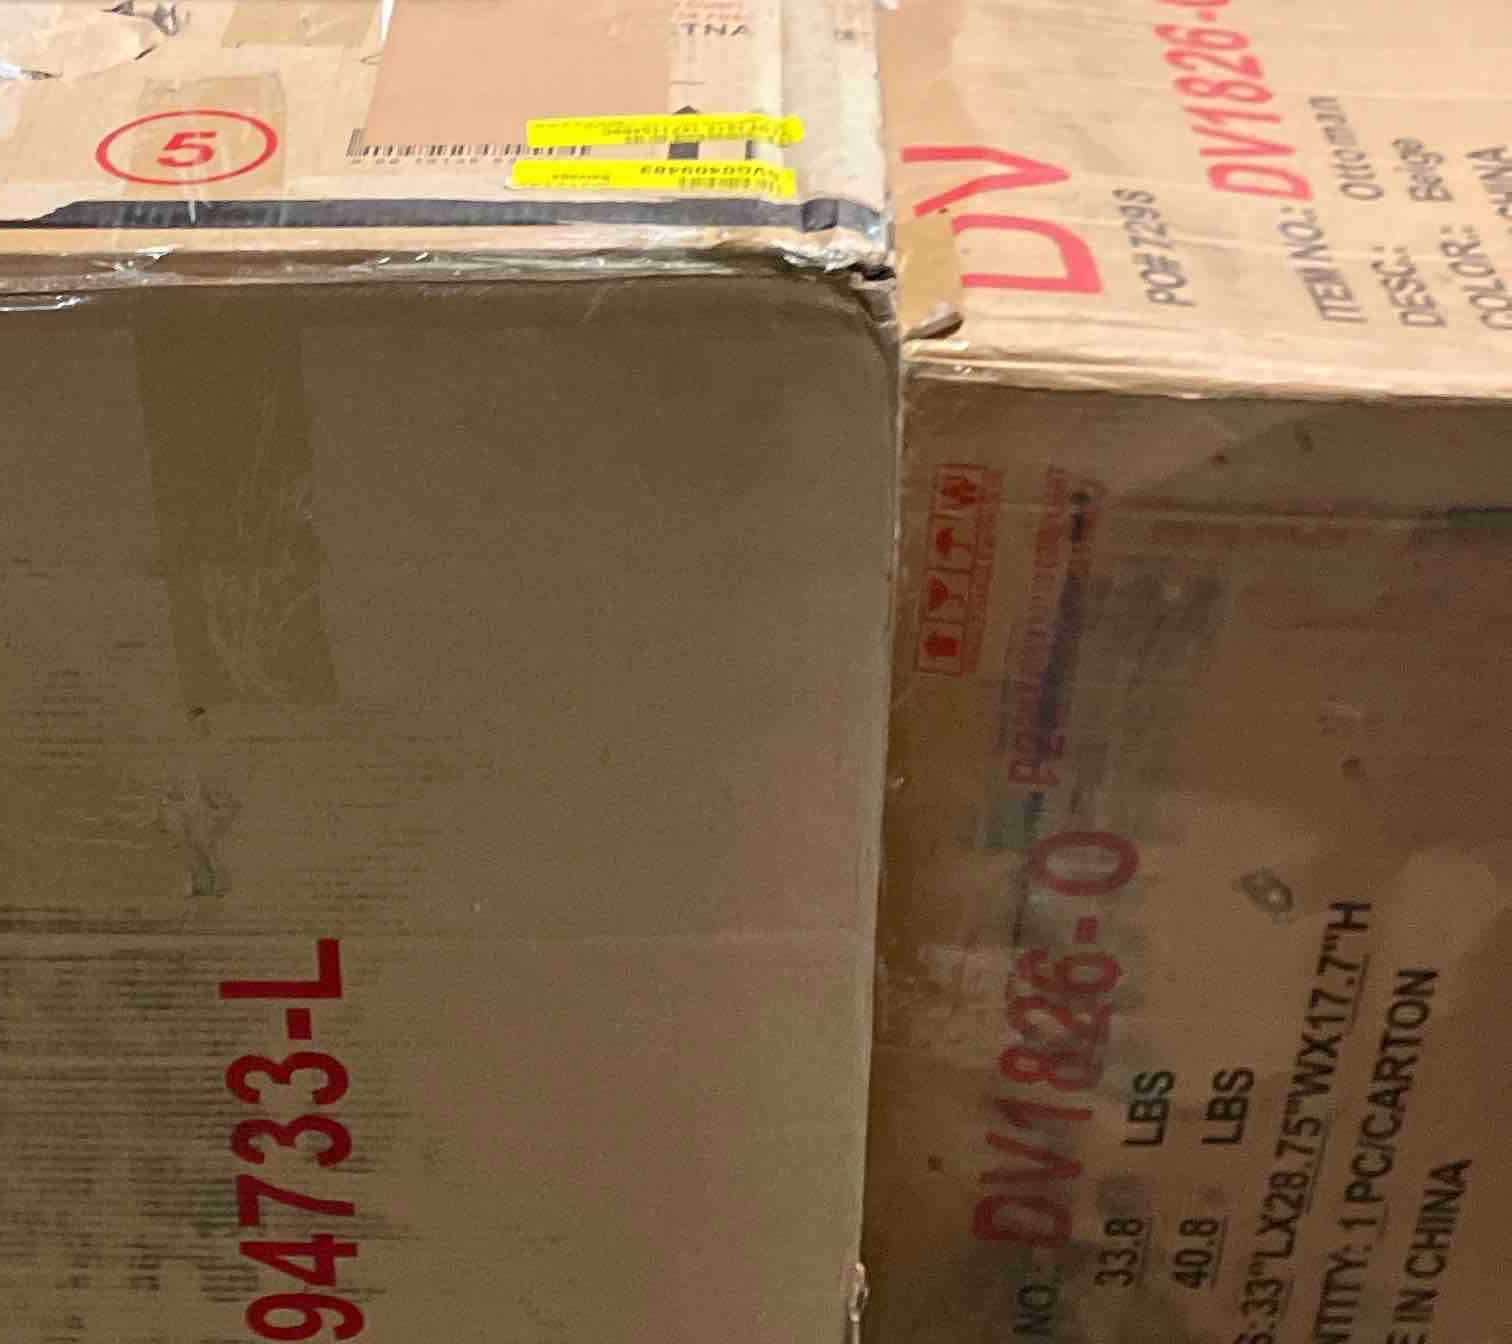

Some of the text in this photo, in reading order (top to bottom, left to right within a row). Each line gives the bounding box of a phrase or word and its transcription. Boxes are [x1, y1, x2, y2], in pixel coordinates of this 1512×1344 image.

[156, 131, 220, 170] 5
[1307, 95, 1384, 202] Ottoman
[1391, 136, 1453, 203] Beige
[899, 146, 1104, 295] DV
[1296, 267, 1368, 324] ITEM
[972, 830, 1140, 1248] DV1826-0
[1346, 966, 1439, 1210] PC/CARTON
[1095, 1216, 1150, 1287] 33.8
[1125, 1070, 1175, 1147] LBS
[1171, 1216, 1226, 1291] 40.8
[1201, 1066, 1255, 1146] LBS
[1406, 1158, 1472, 1278] CHINA
[1397, 1287, 1436, 1329] IN
